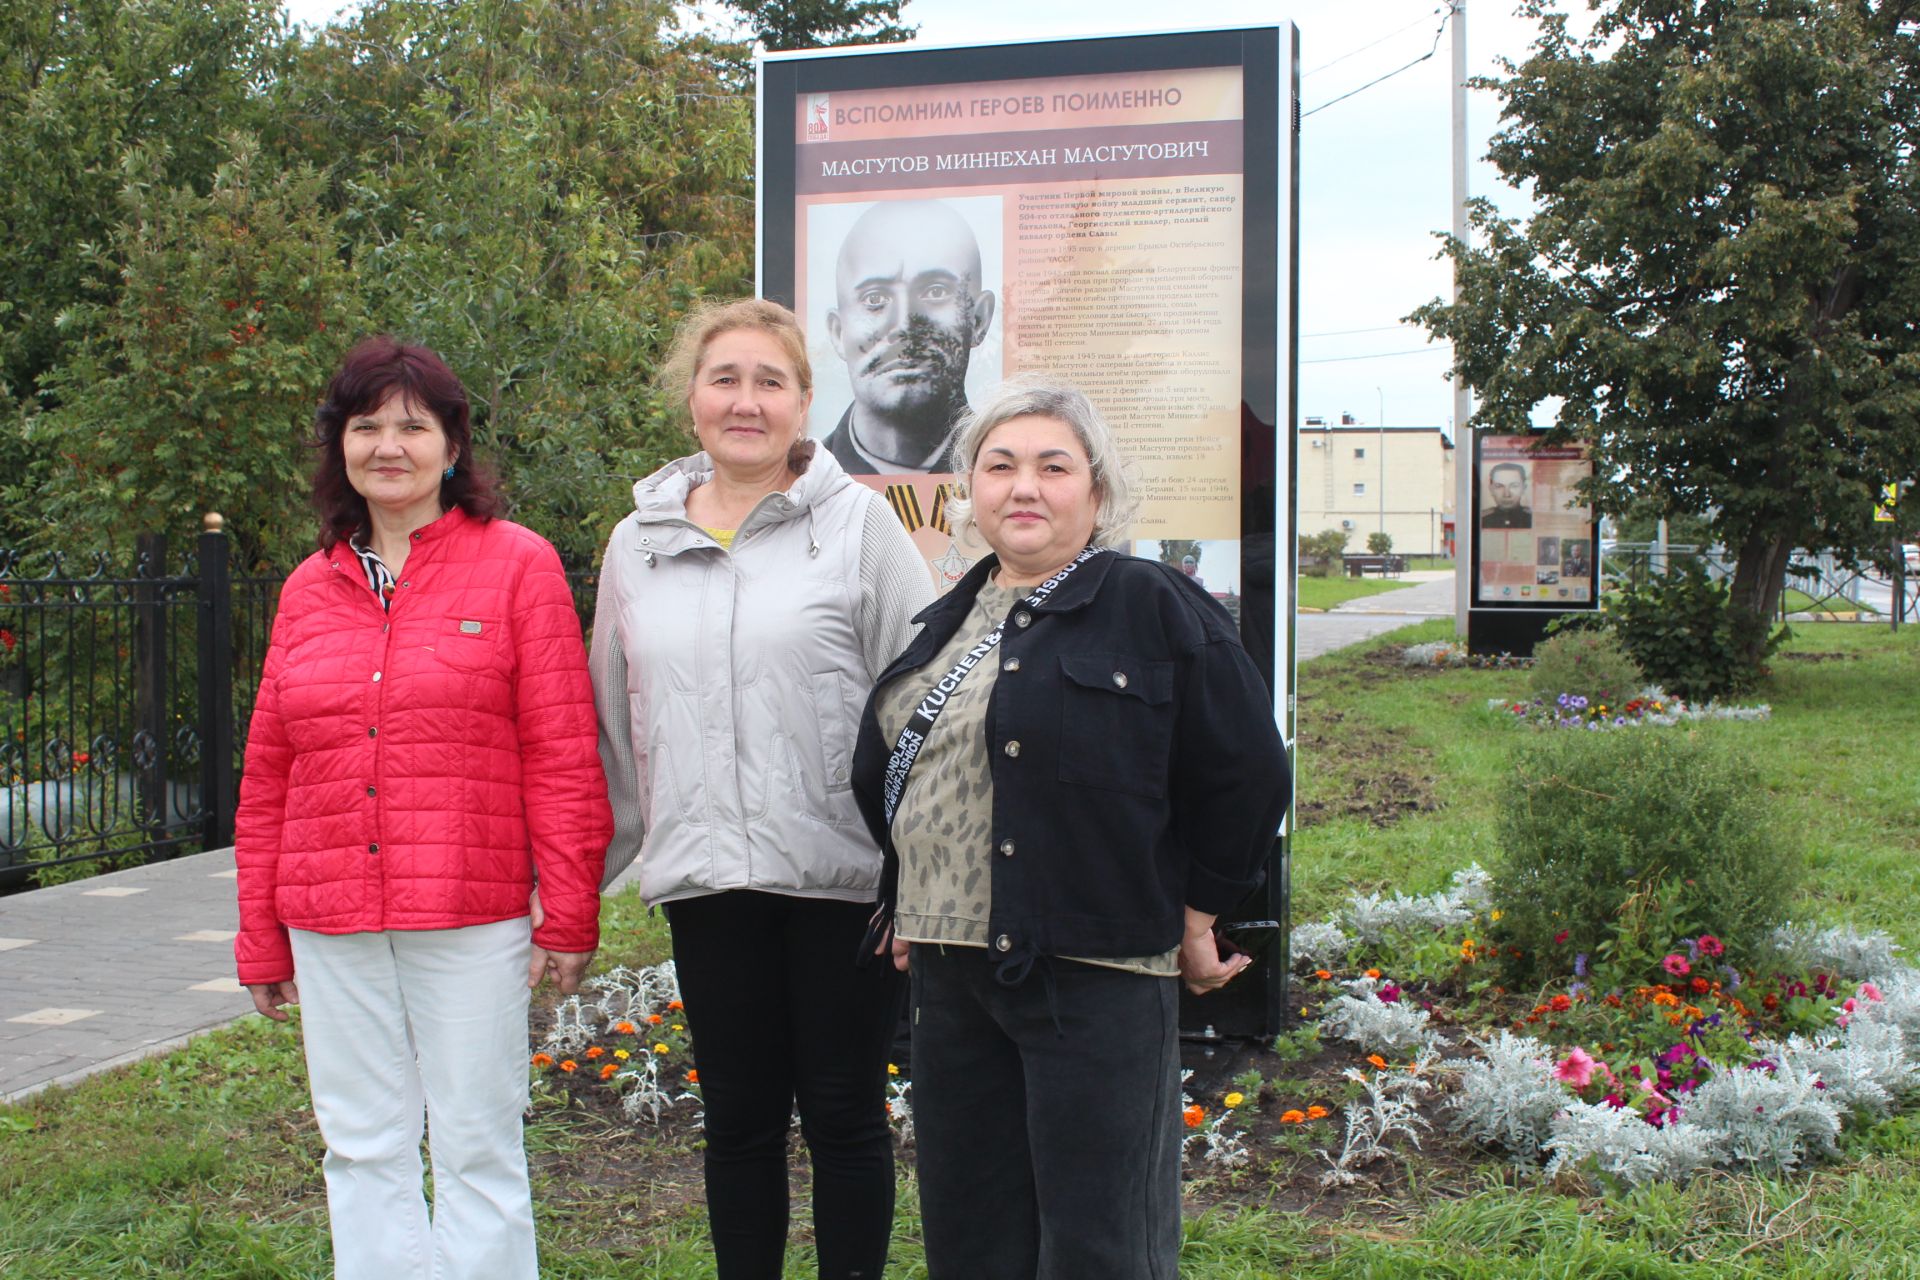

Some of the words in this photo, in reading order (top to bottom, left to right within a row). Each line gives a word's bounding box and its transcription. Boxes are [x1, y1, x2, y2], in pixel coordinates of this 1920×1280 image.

[835, 101, 963, 125] ВСПОМНИМ
[970, 96, 1045, 117] ГЕРОЕВ
[1052, 87, 1182, 113] ПОИМЕННО
[821, 156, 929, 177] МАСГУТОВ
[935, 149, 1057, 171] МИННЕХАН
[1063, 140, 1209, 164] МАСГУТОВИЧ
[1018, 191, 1060, 201] Участник
[1063, 190, 1096, 200] Первой
[1098, 188, 1138, 199] мировой
[1183, 186, 1225, 194] Великую
[1018, 201, 1089, 211] Отечественную
[1091, 199, 1118, 208] войну
[1120, 198, 1163, 207] младший
[1018, 212, 1047, 221] 504-го
[1049, 210, 1100, 220] отдельного
[1068, 219, 1131, 230] Георгиевский
[1173, 215, 1209, 225] полный
[1018, 231, 1053, 241] кавалер
[1055, 230, 1087, 240] ордена
[888, 732, 924, 808] NEWFASHION
